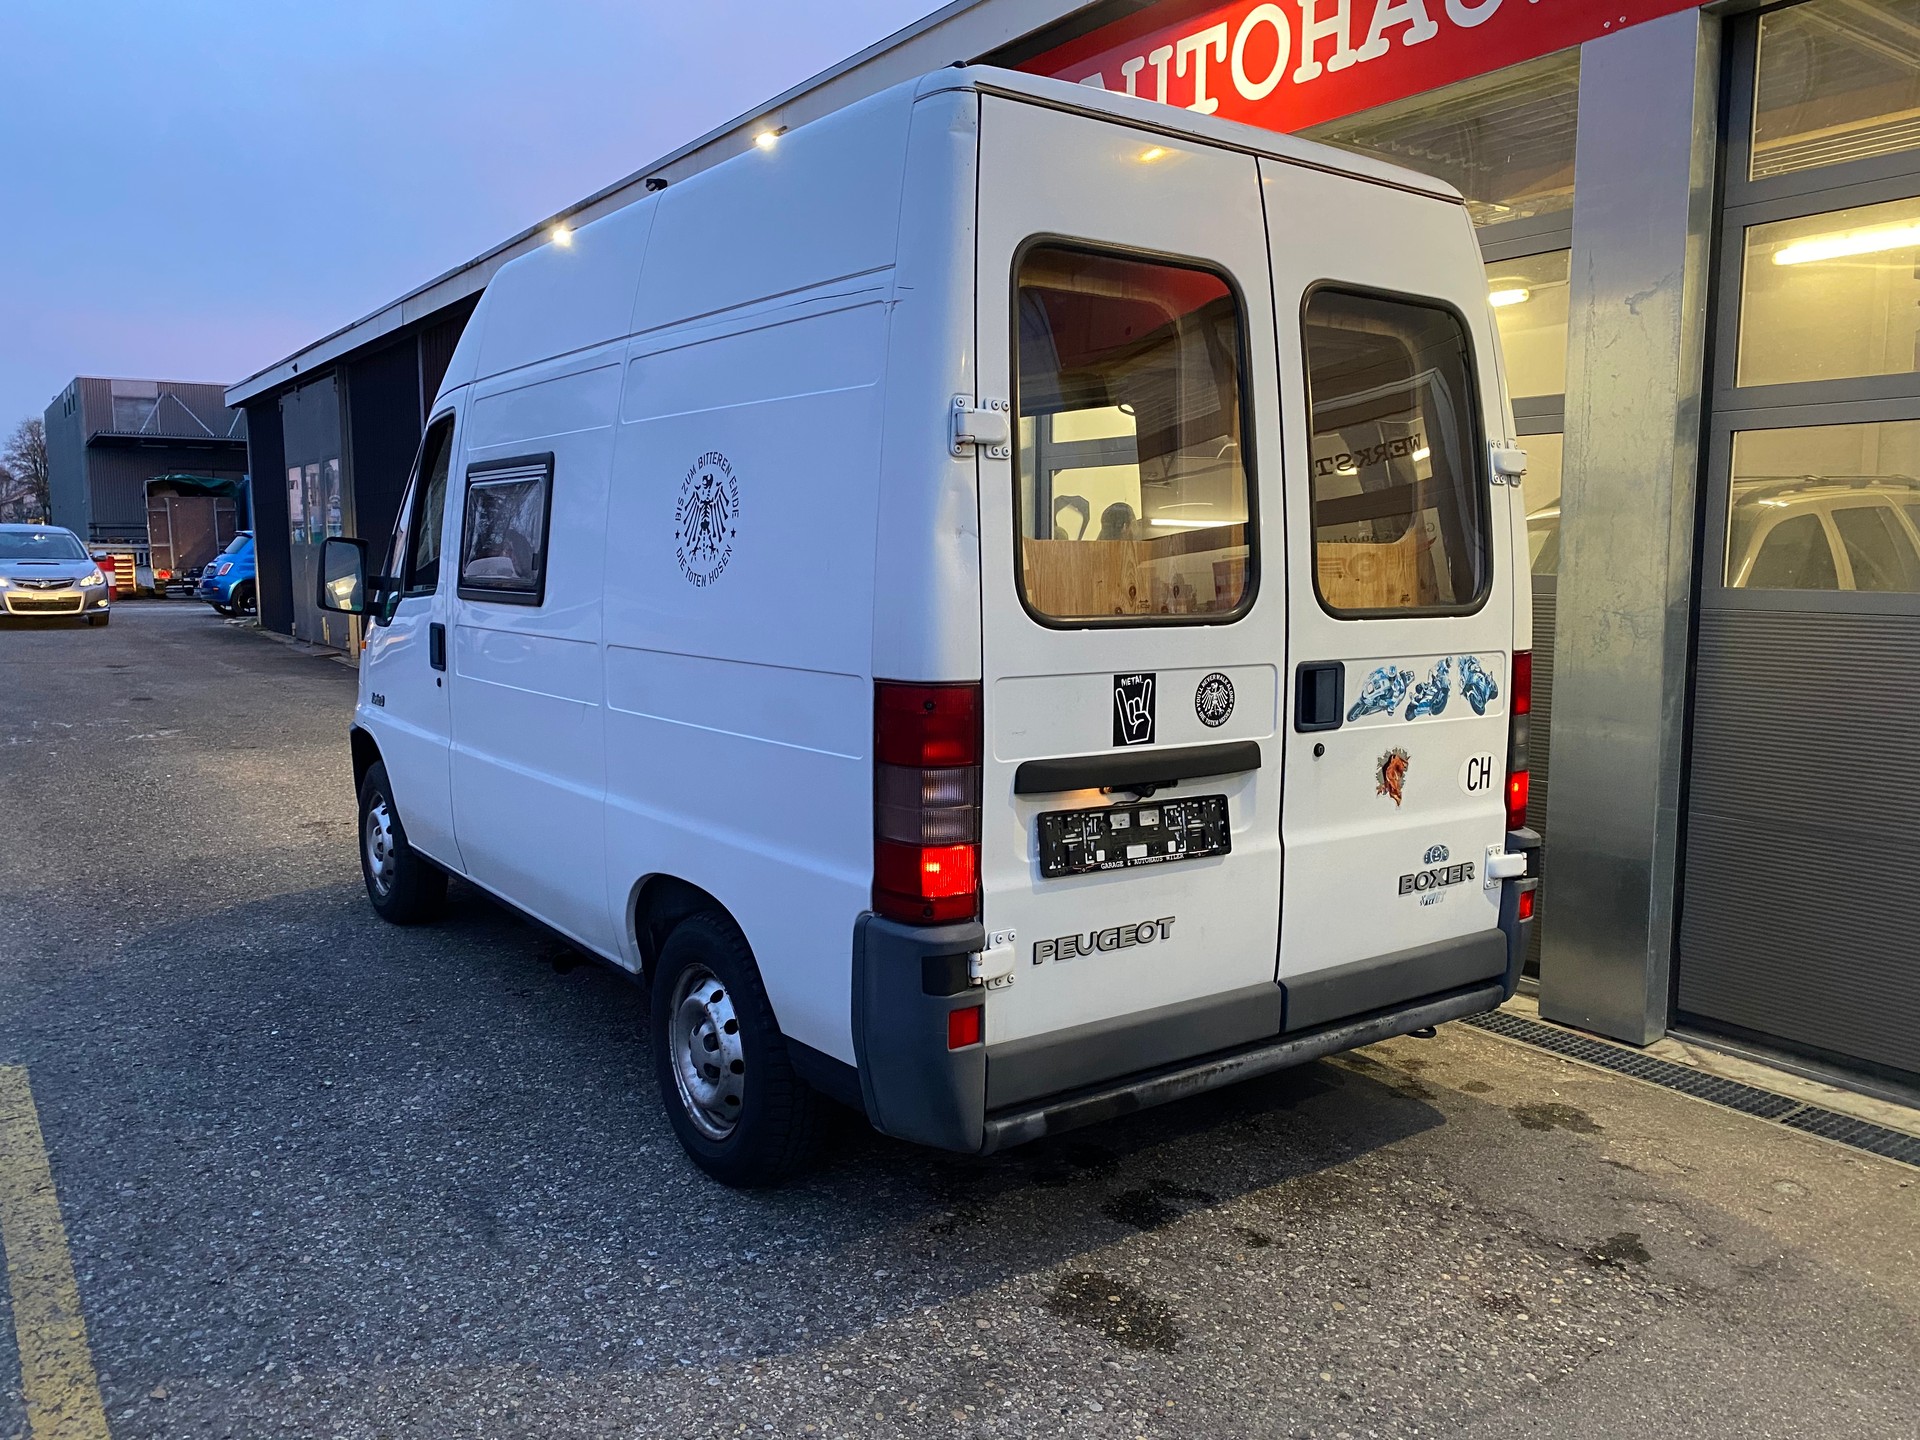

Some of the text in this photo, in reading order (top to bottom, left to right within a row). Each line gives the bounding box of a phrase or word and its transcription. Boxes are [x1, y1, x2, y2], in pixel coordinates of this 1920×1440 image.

[1079, 0, 1540, 116] UTOHA
[675, 451, 740, 521] BIS ZUM BITTEREN ENDE
[675, 544, 732, 587] DIE TOTEN HOSEN
[1121, 675, 1144, 687] METAL
[1467, 756, 1492, 791] CH
[1100, 860, 1125, 870] GARAGE
[1133, 856, 1164, 865] AUTOHAUS
[1398, 861, 1476, 896] BOXER
[1033, 916, 1176, 965] PEUGEOT
